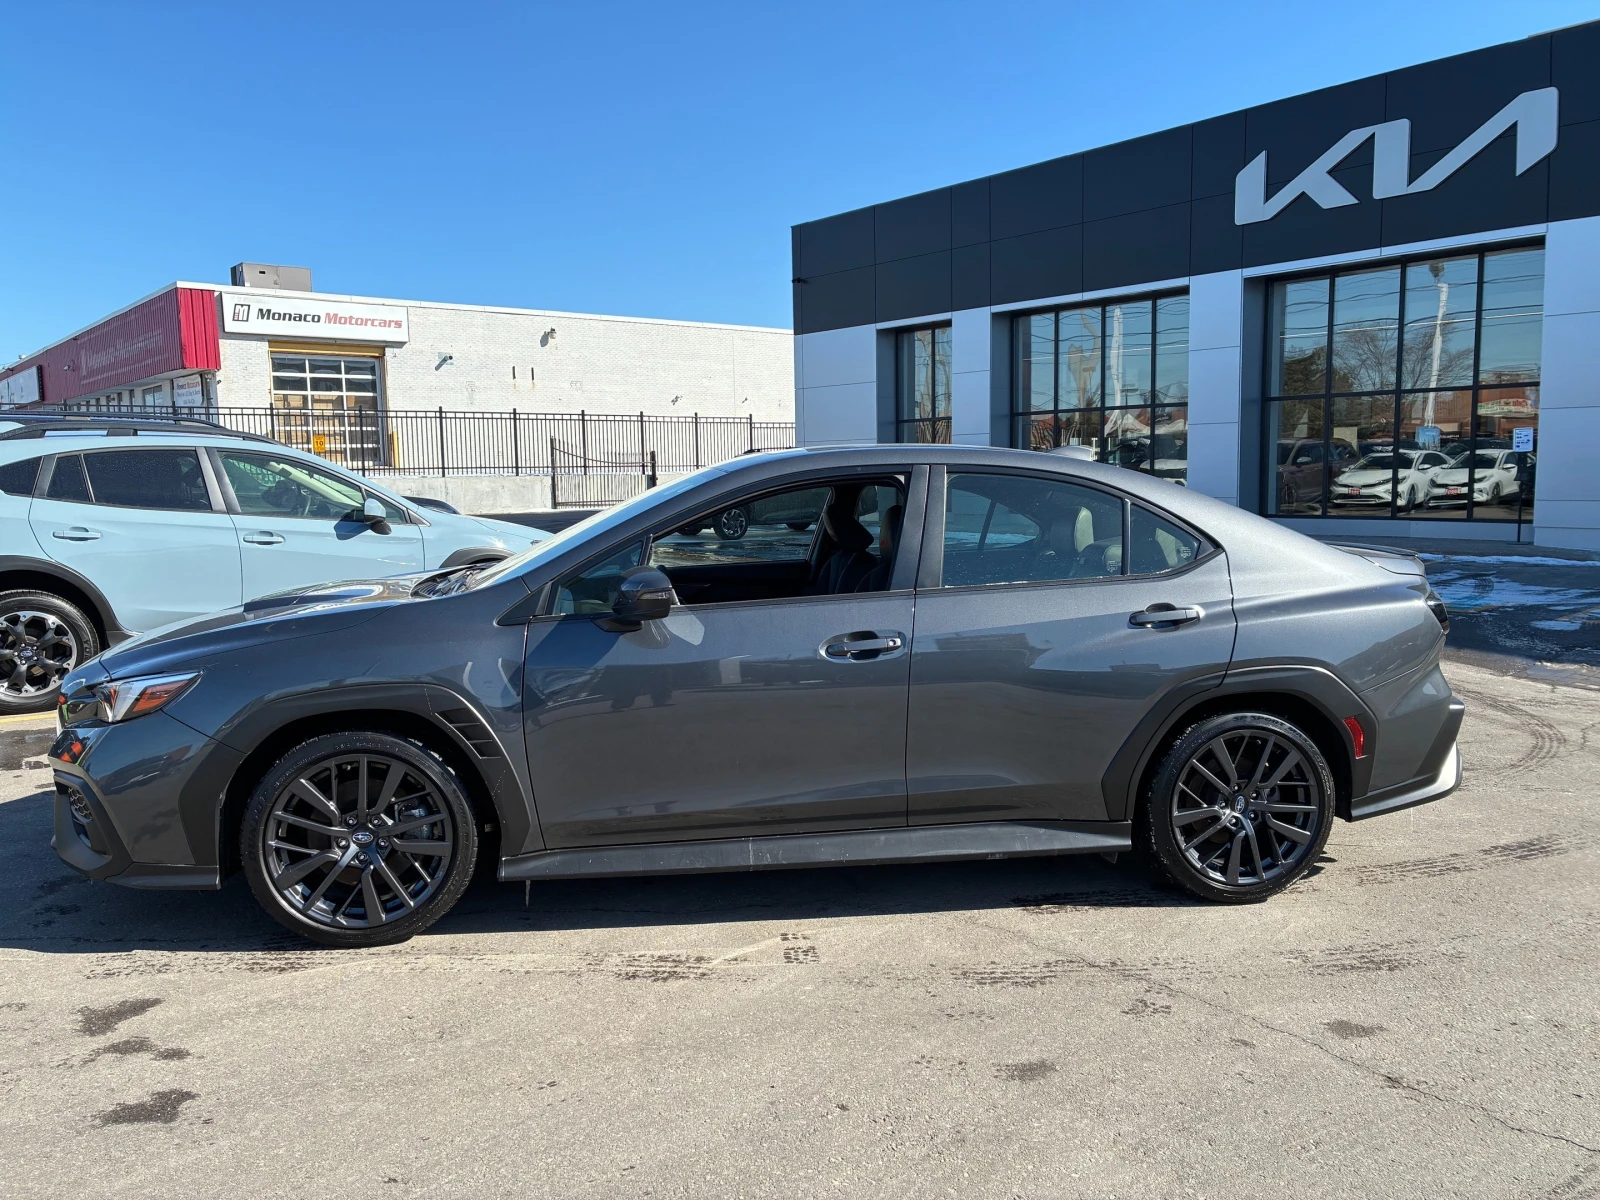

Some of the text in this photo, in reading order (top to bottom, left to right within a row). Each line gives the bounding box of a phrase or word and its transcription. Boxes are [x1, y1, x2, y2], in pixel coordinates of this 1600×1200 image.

[1235, 86, 1559, 225] KIA
[256, 308, 403, 329] Monaco Motorcars
